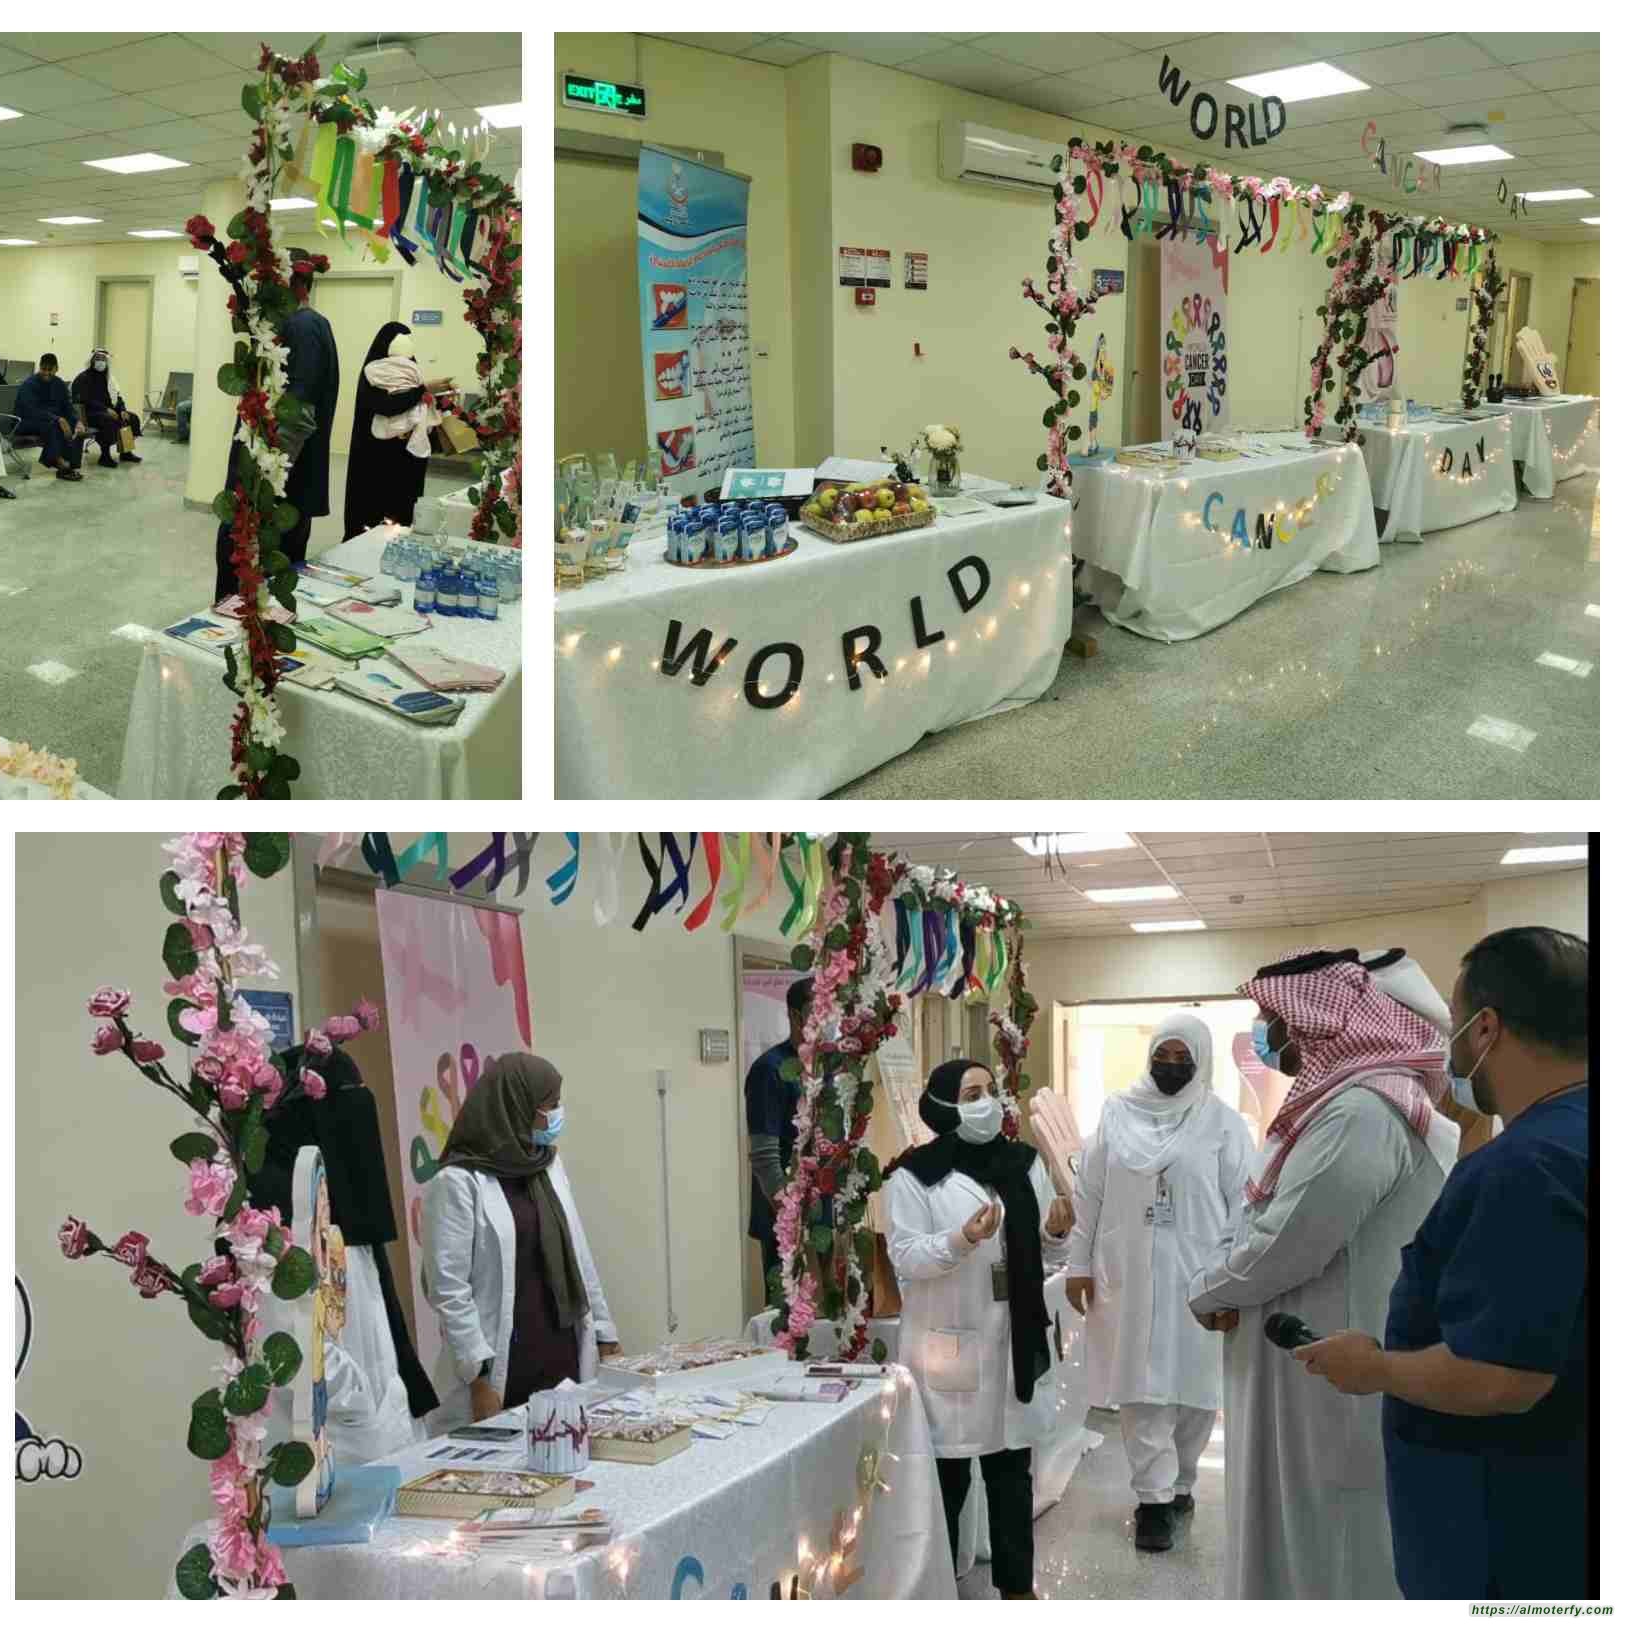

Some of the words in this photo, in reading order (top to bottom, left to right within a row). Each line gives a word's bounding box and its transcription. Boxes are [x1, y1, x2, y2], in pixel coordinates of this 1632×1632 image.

[567, 83, 595, 100] EXIT
[1159, 54, 1286, 149] WORLD
[1185, 353, 1210, 371] CANCER
[1439, 435, 1485, 479] DAY
[661, 555, 991, 709] WORLD
